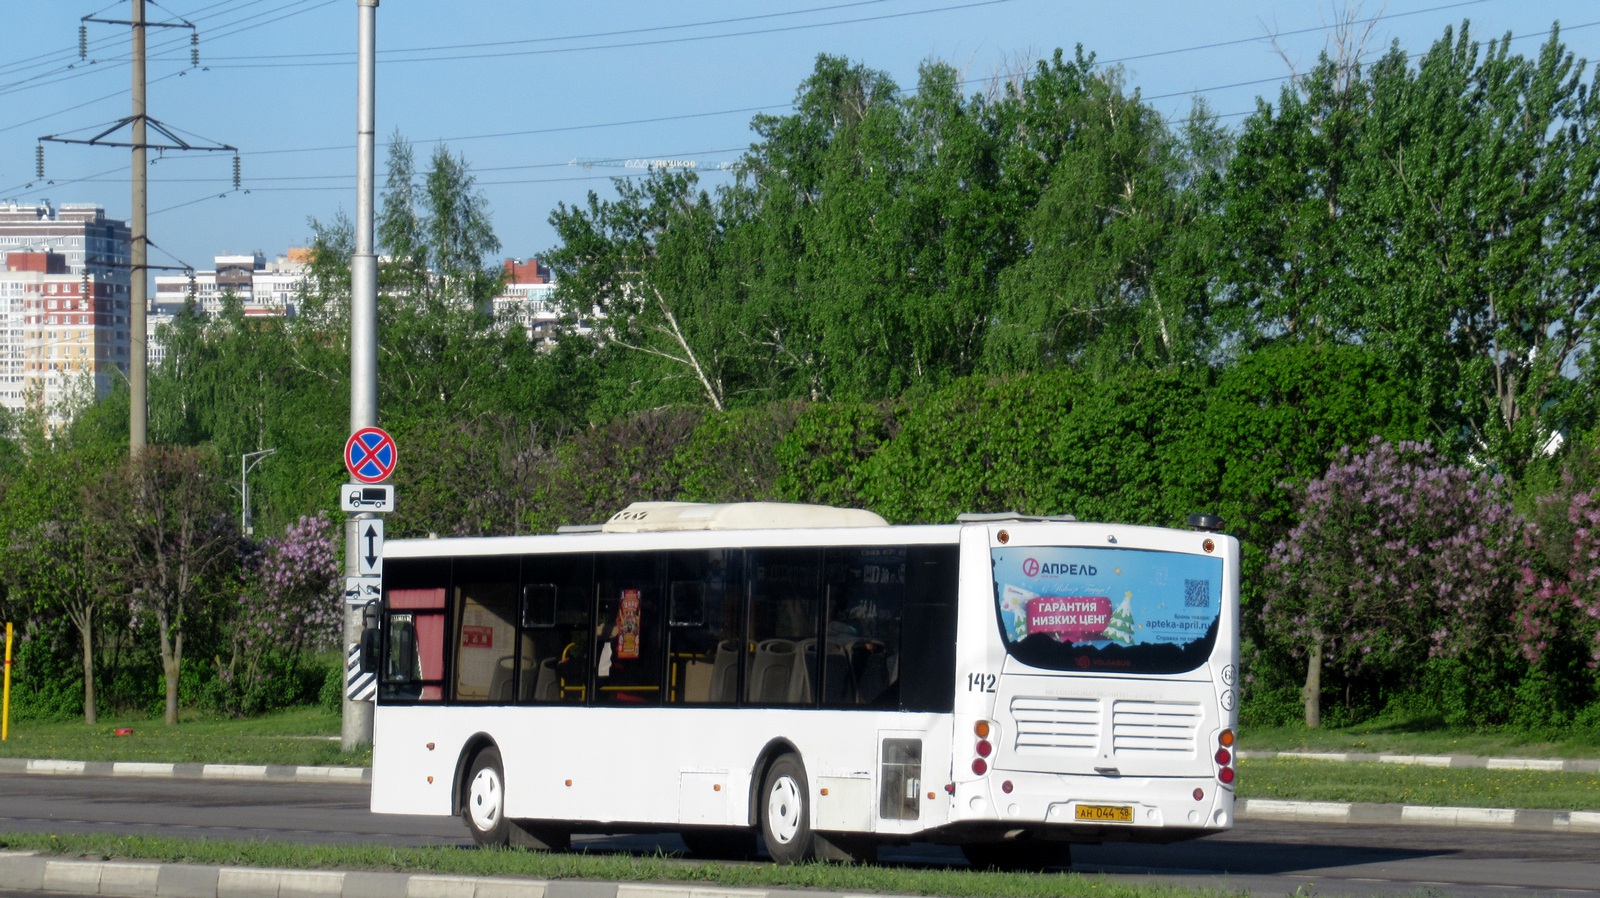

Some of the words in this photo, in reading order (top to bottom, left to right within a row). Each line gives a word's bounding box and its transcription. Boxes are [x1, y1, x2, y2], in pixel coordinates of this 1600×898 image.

[1041, 562, 1097, 576] АПРЕЛЬ
[1038, 602, 1097, 613] ГАРАНТИЯ
[1032, 615, 1077, 626] НИЗКИХ
[1145, 619, 1210, 631] apteka-april.ru
[1224, 669, 1235, 680] 60
[968, 672, 996, 694] 142
[1227, 695, 1232, 706] 3
[1080, 809, 1093, 818] АН
[1096, 808, 1115, 818] 044
[1119, 808, 1129, 817] 48
